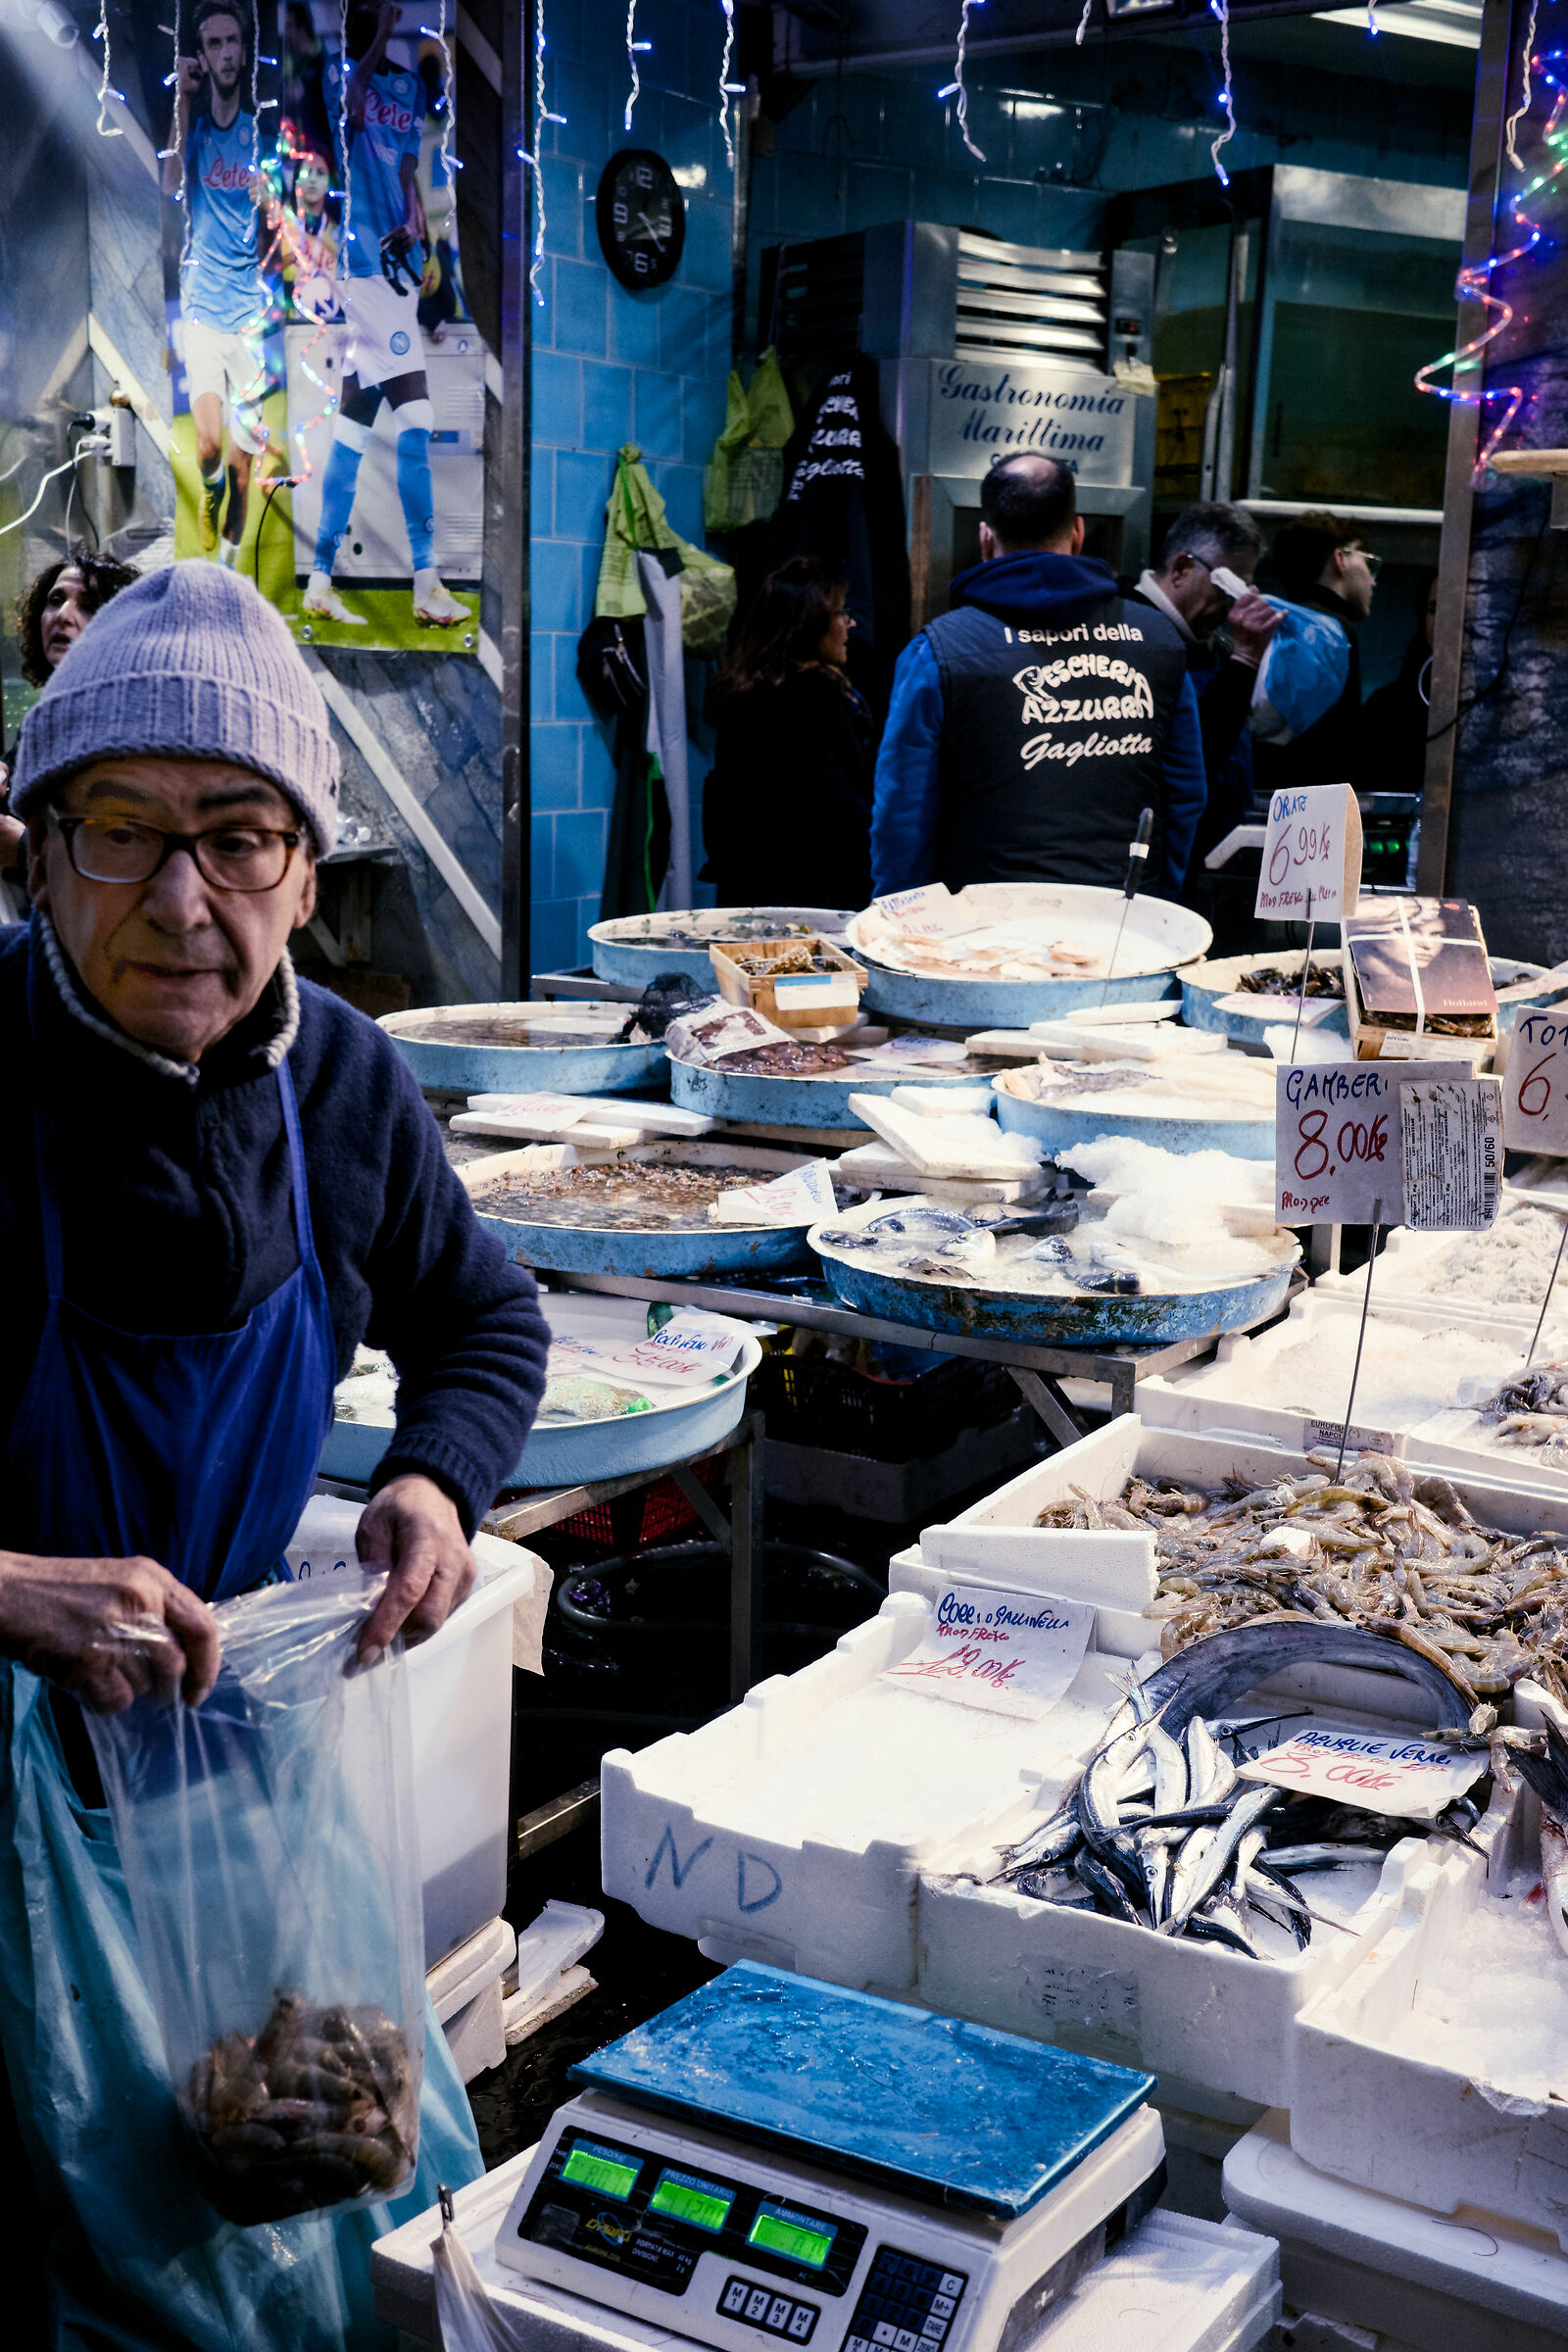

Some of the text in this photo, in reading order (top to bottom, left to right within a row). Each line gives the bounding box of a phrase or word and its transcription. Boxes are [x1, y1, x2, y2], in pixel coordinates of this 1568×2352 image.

[938, 366, 1125, 415] Gastronomia
[962, 409, 1105, 453] Marittima
[1004, 623, 1144, 646] I sapori della
[1021, 694, 1153, 724] AZZURRA
[1020, 732, 1153, 770] Gagliotta
[1273, 795, 1307, 822] ORATE
[1286, 1069, 1389, 1110] GAMBERI
[1485, 1137, 1494, 1167] 50/60
[1319, 1430, 1344, 1439] NAPOL
[737, 1849, 782, 1913] D
[665, 2169, 696, 2185] PREZZO
[775, 2208, 826, 2231] AMMONTARE
[732, 2287, 743, 2297] M
[947, 2279, 956, 2290] C
[754, 2295, 764, 2305] M
[934, 2299, 951, 2312] M+
[752, 2306, 759, 2315] 2
[775, 2303, 786, 2314] M
[772, 2314, 780, 2324] 3
[798, 2312, 808, 2323] M
[900, 2334, 911, 2347] M
